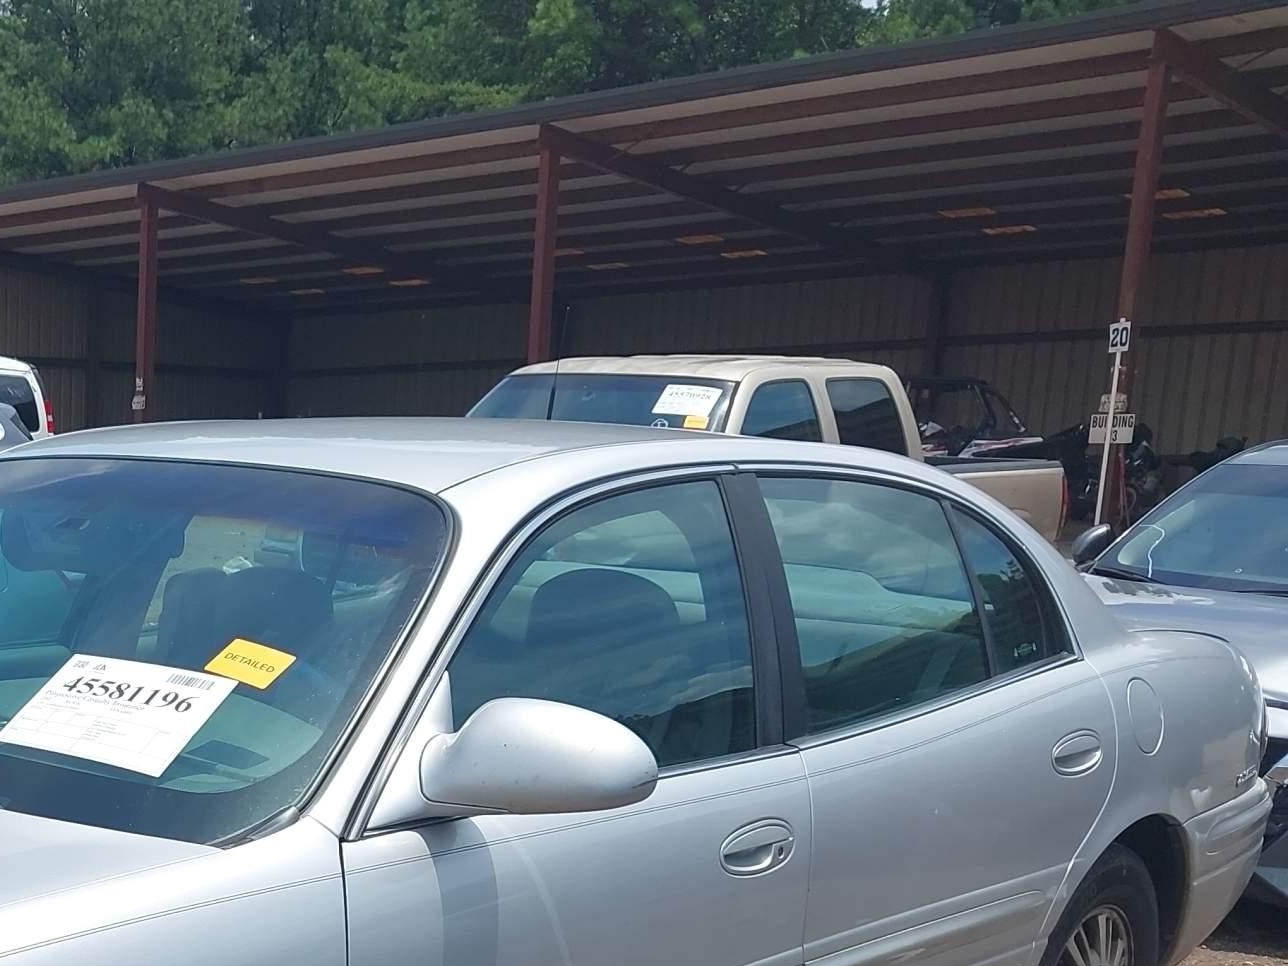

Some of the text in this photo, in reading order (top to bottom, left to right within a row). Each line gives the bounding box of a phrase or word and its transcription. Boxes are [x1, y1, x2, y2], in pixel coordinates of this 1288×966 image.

[1110, 326, 1129, 348] 20
[1091, 415, 1134, 429] BUIDING
[223, 652, 276, 673] DETAILED
[63, 676, 201, 713] 45581196
